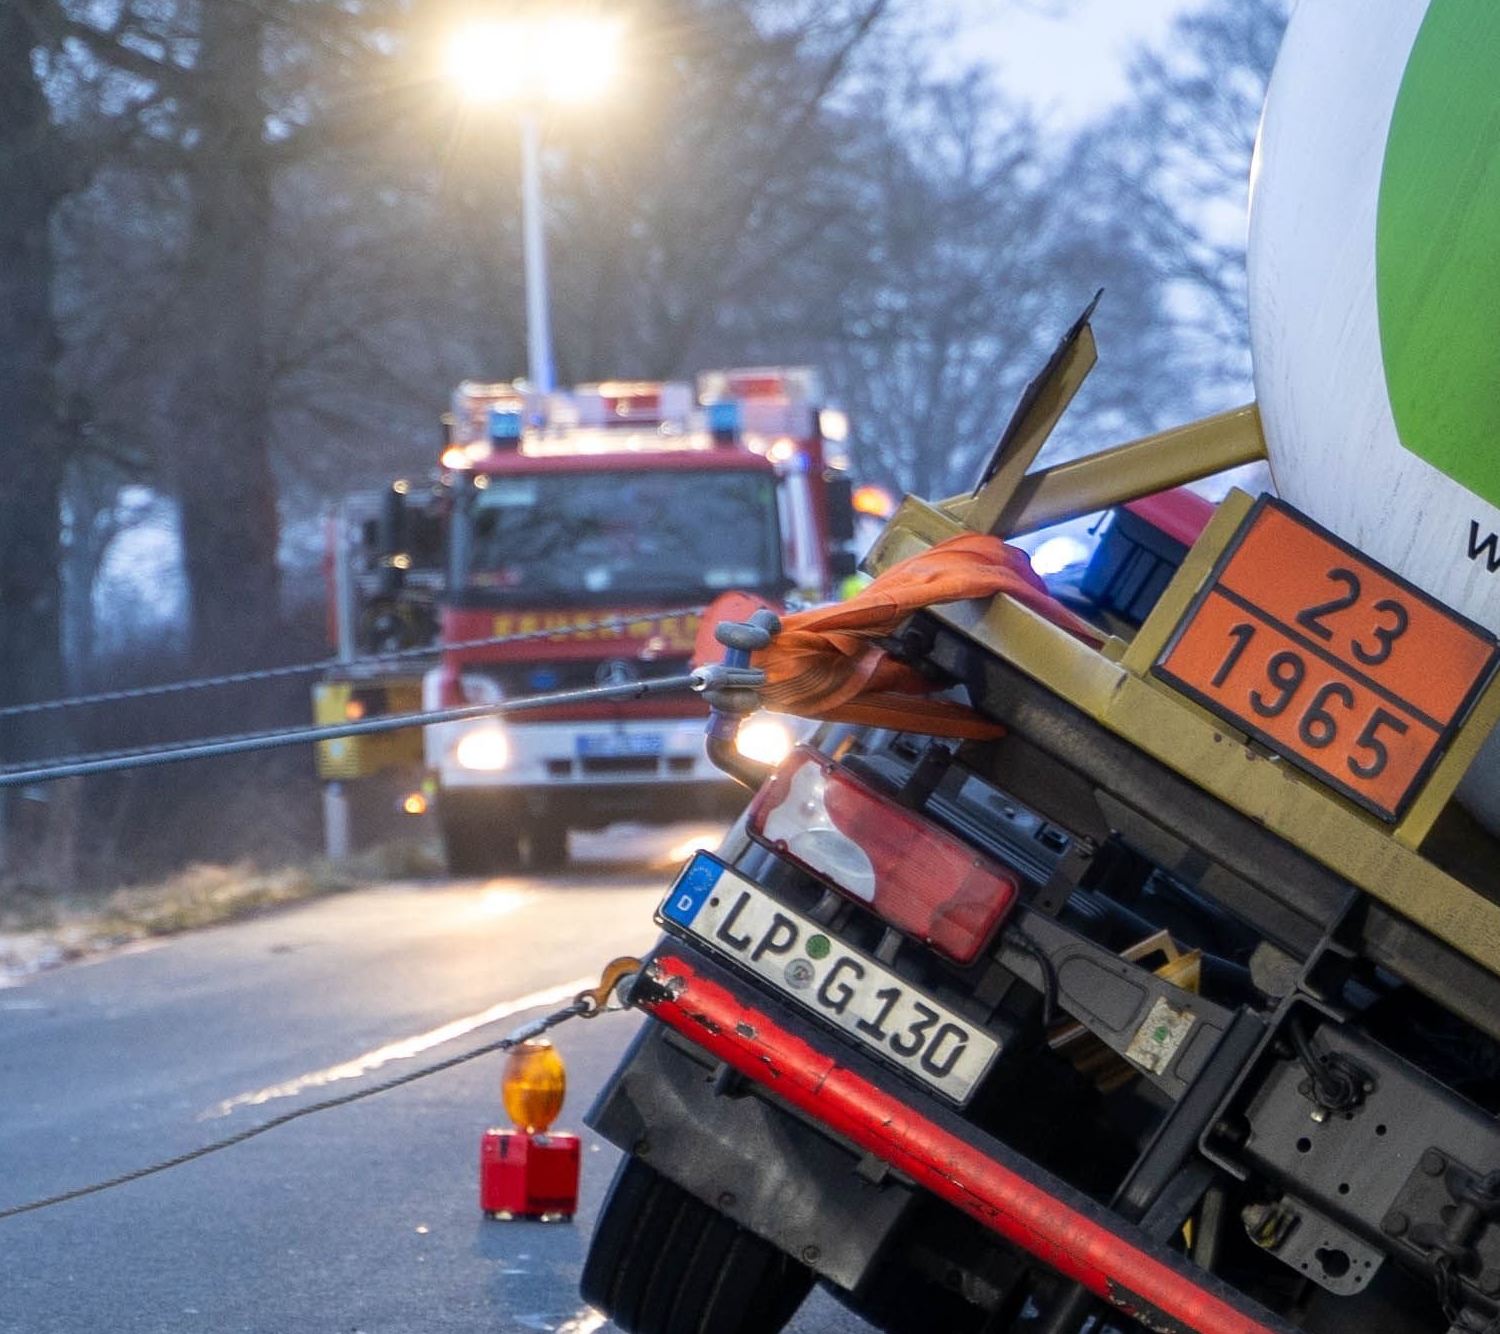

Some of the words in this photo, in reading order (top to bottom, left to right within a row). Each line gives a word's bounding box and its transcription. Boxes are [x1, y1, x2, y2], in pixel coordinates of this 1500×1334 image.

[1296, 567, 1409, 667] 23
[1208, 623, 1410, 780] 1965
[678, 894, 693, 912] D
[716, 891, 800, 962] LP
[816, 956, 865, 1016] G
[855, 987, 970, 1079] 130
